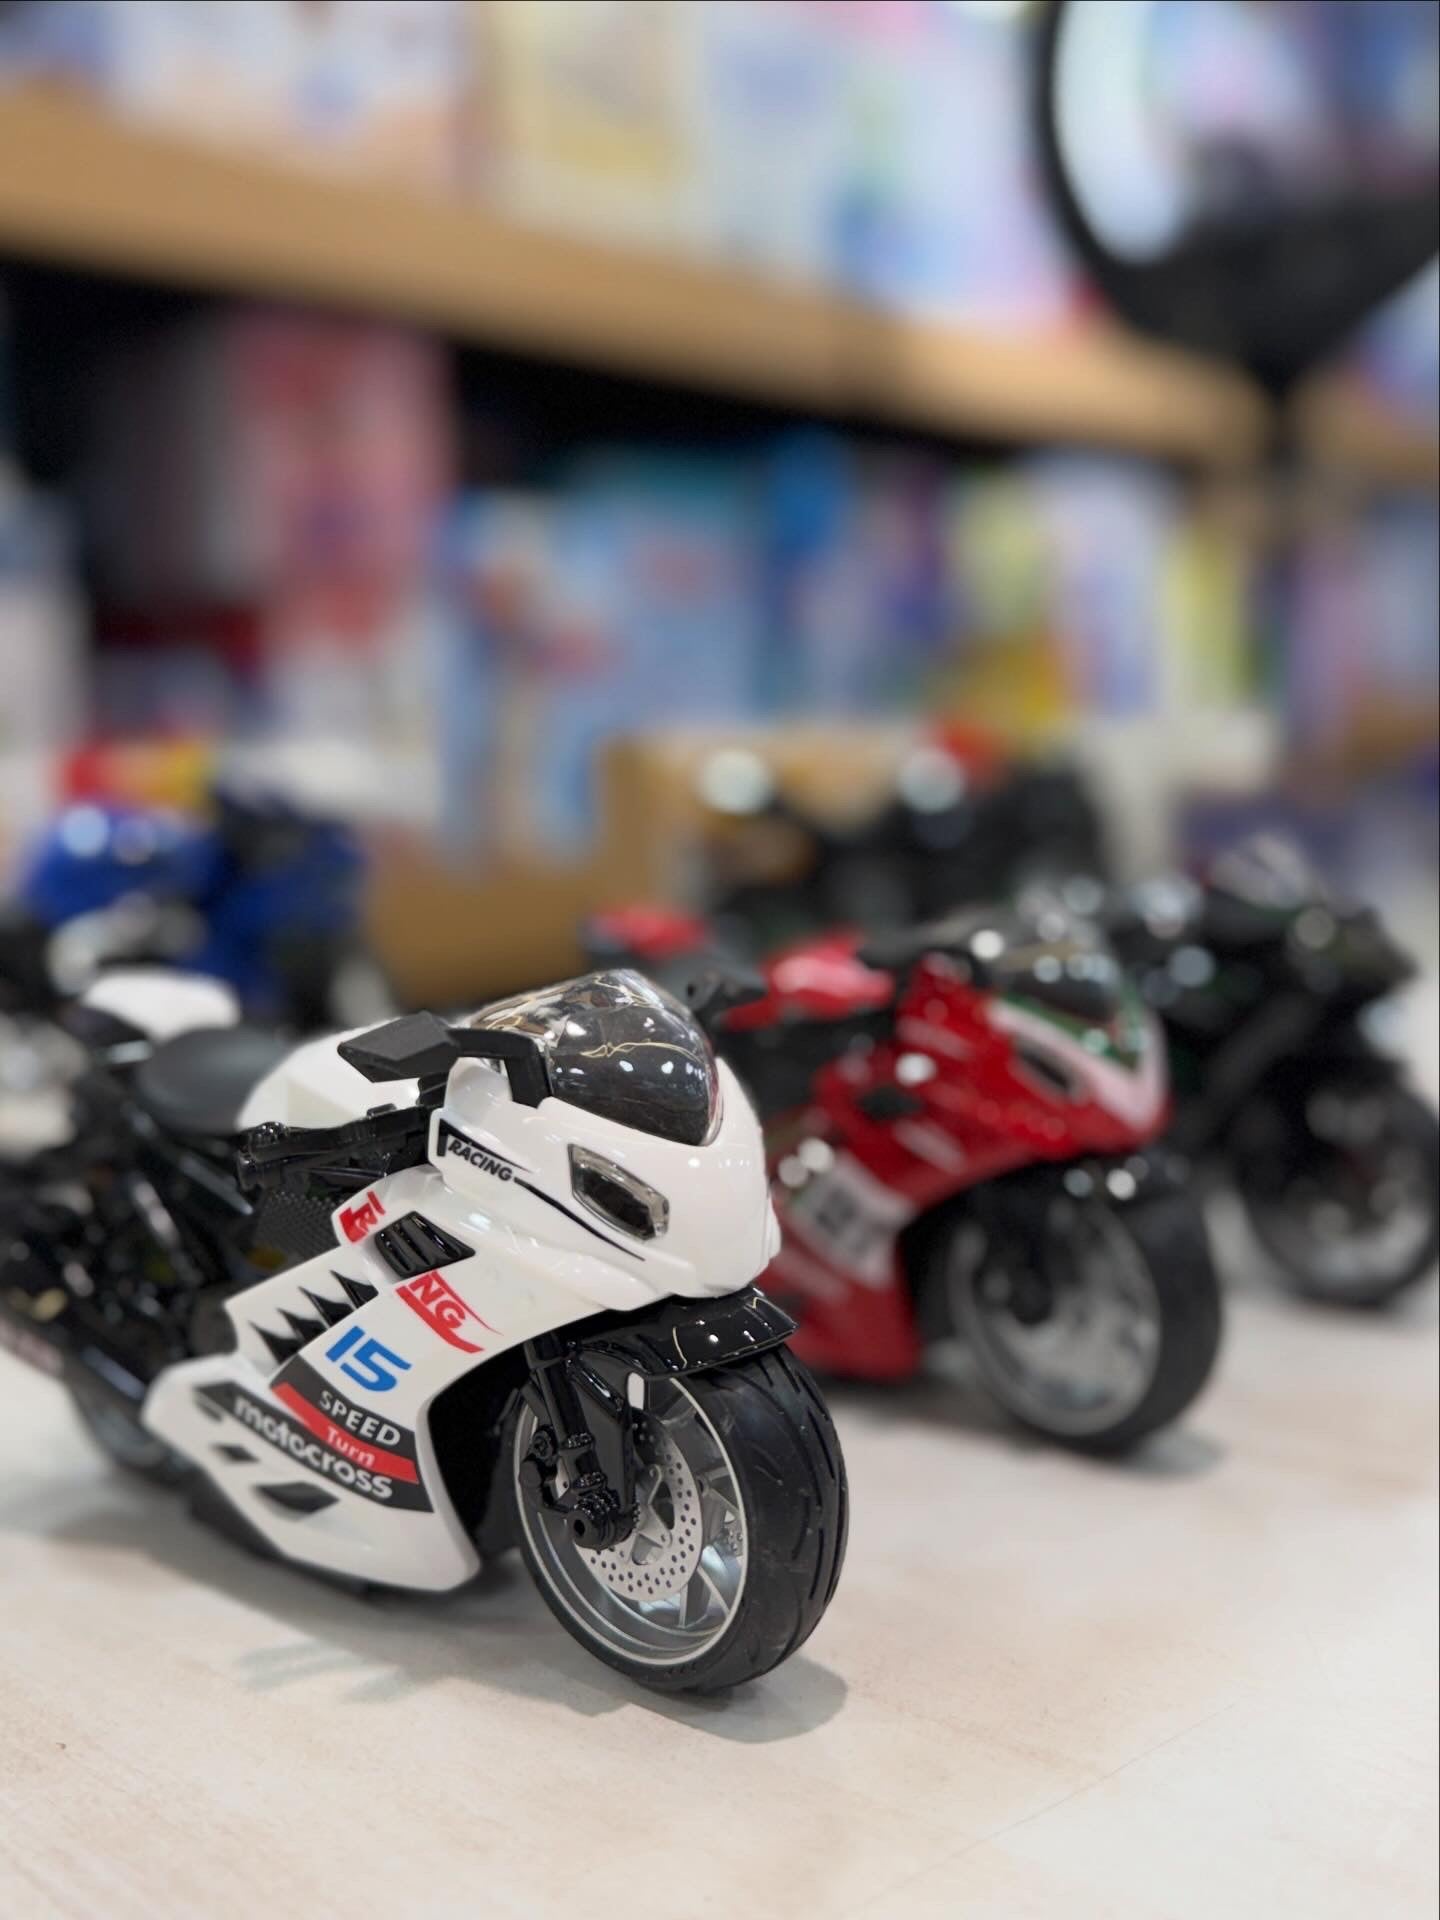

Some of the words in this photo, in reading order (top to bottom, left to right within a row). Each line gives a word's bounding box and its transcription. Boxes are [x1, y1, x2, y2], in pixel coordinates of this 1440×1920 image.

[448, 1139, 512, 1181] RACING
[408, 1274, 466, 1329] NG
[325, 1326, 412, 1392] 15
[320, 1390, 401, 1446] SPEED
[233, 1397, 393, 1498] motocross
[327, 1425, 375, 1467] Turn
